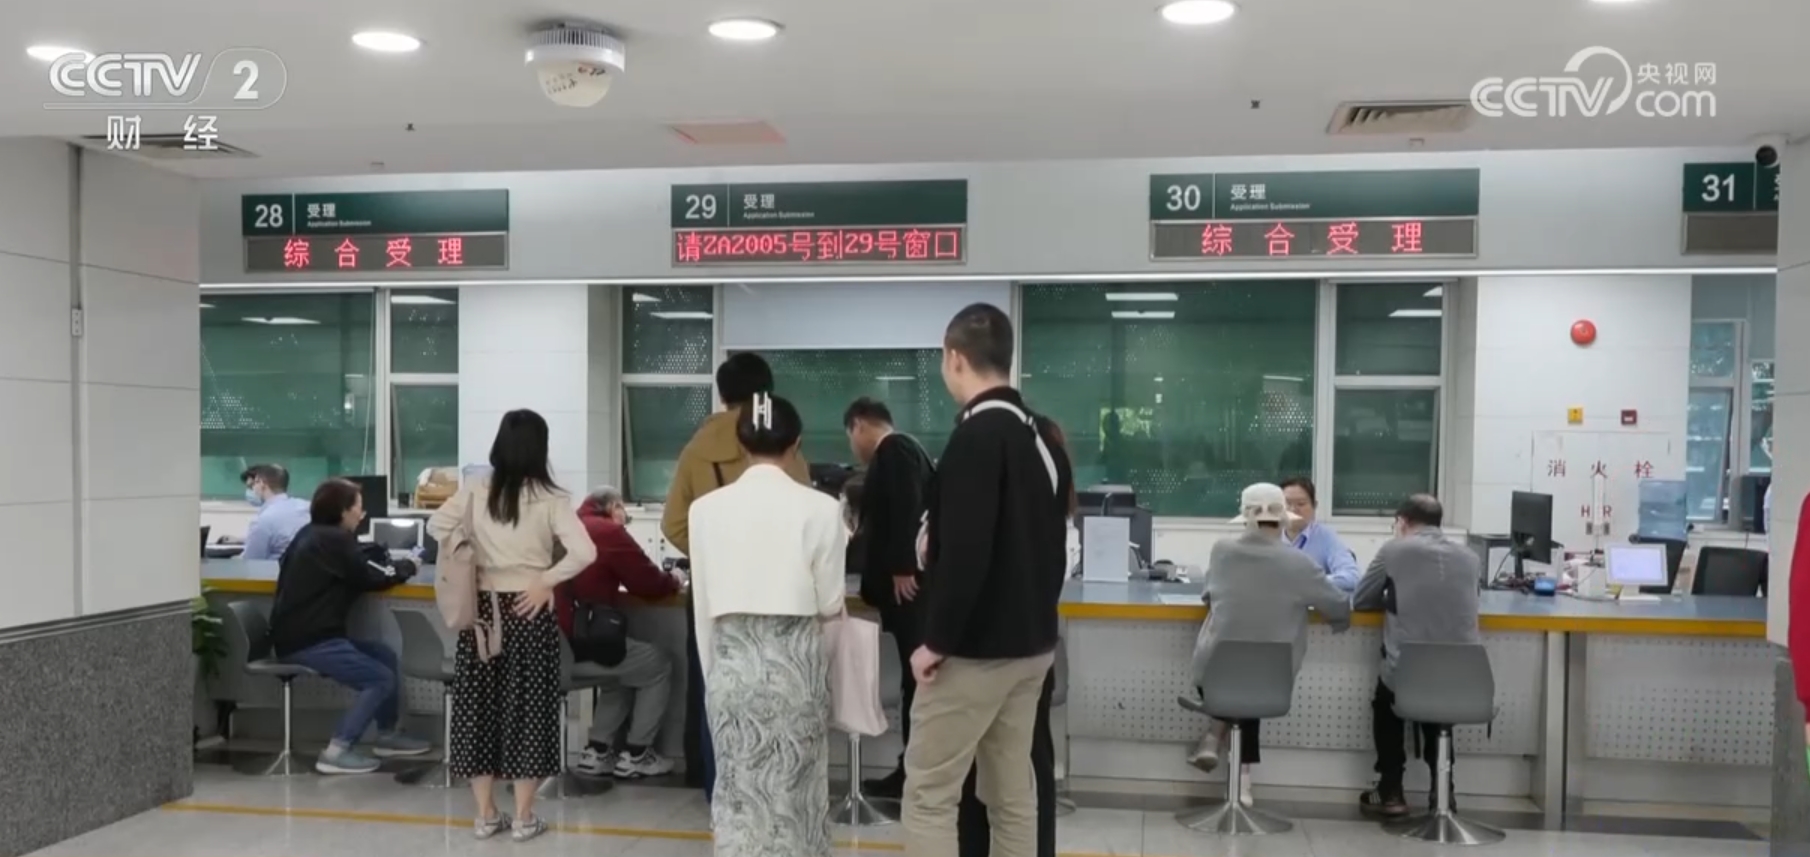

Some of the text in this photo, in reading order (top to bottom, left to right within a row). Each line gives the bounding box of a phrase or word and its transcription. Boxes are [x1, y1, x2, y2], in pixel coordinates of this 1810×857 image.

[1165, 184, 1201, 211] 30
[1230, 183, 1266, 200] 受理
[1701, 172, 1736, 203] 31
[307, 203, 336, 218] 受理
[685, 194, 717, 220] 29
[743, 193, 775, 210] 受理
[254, 203, 283, 228] 28
